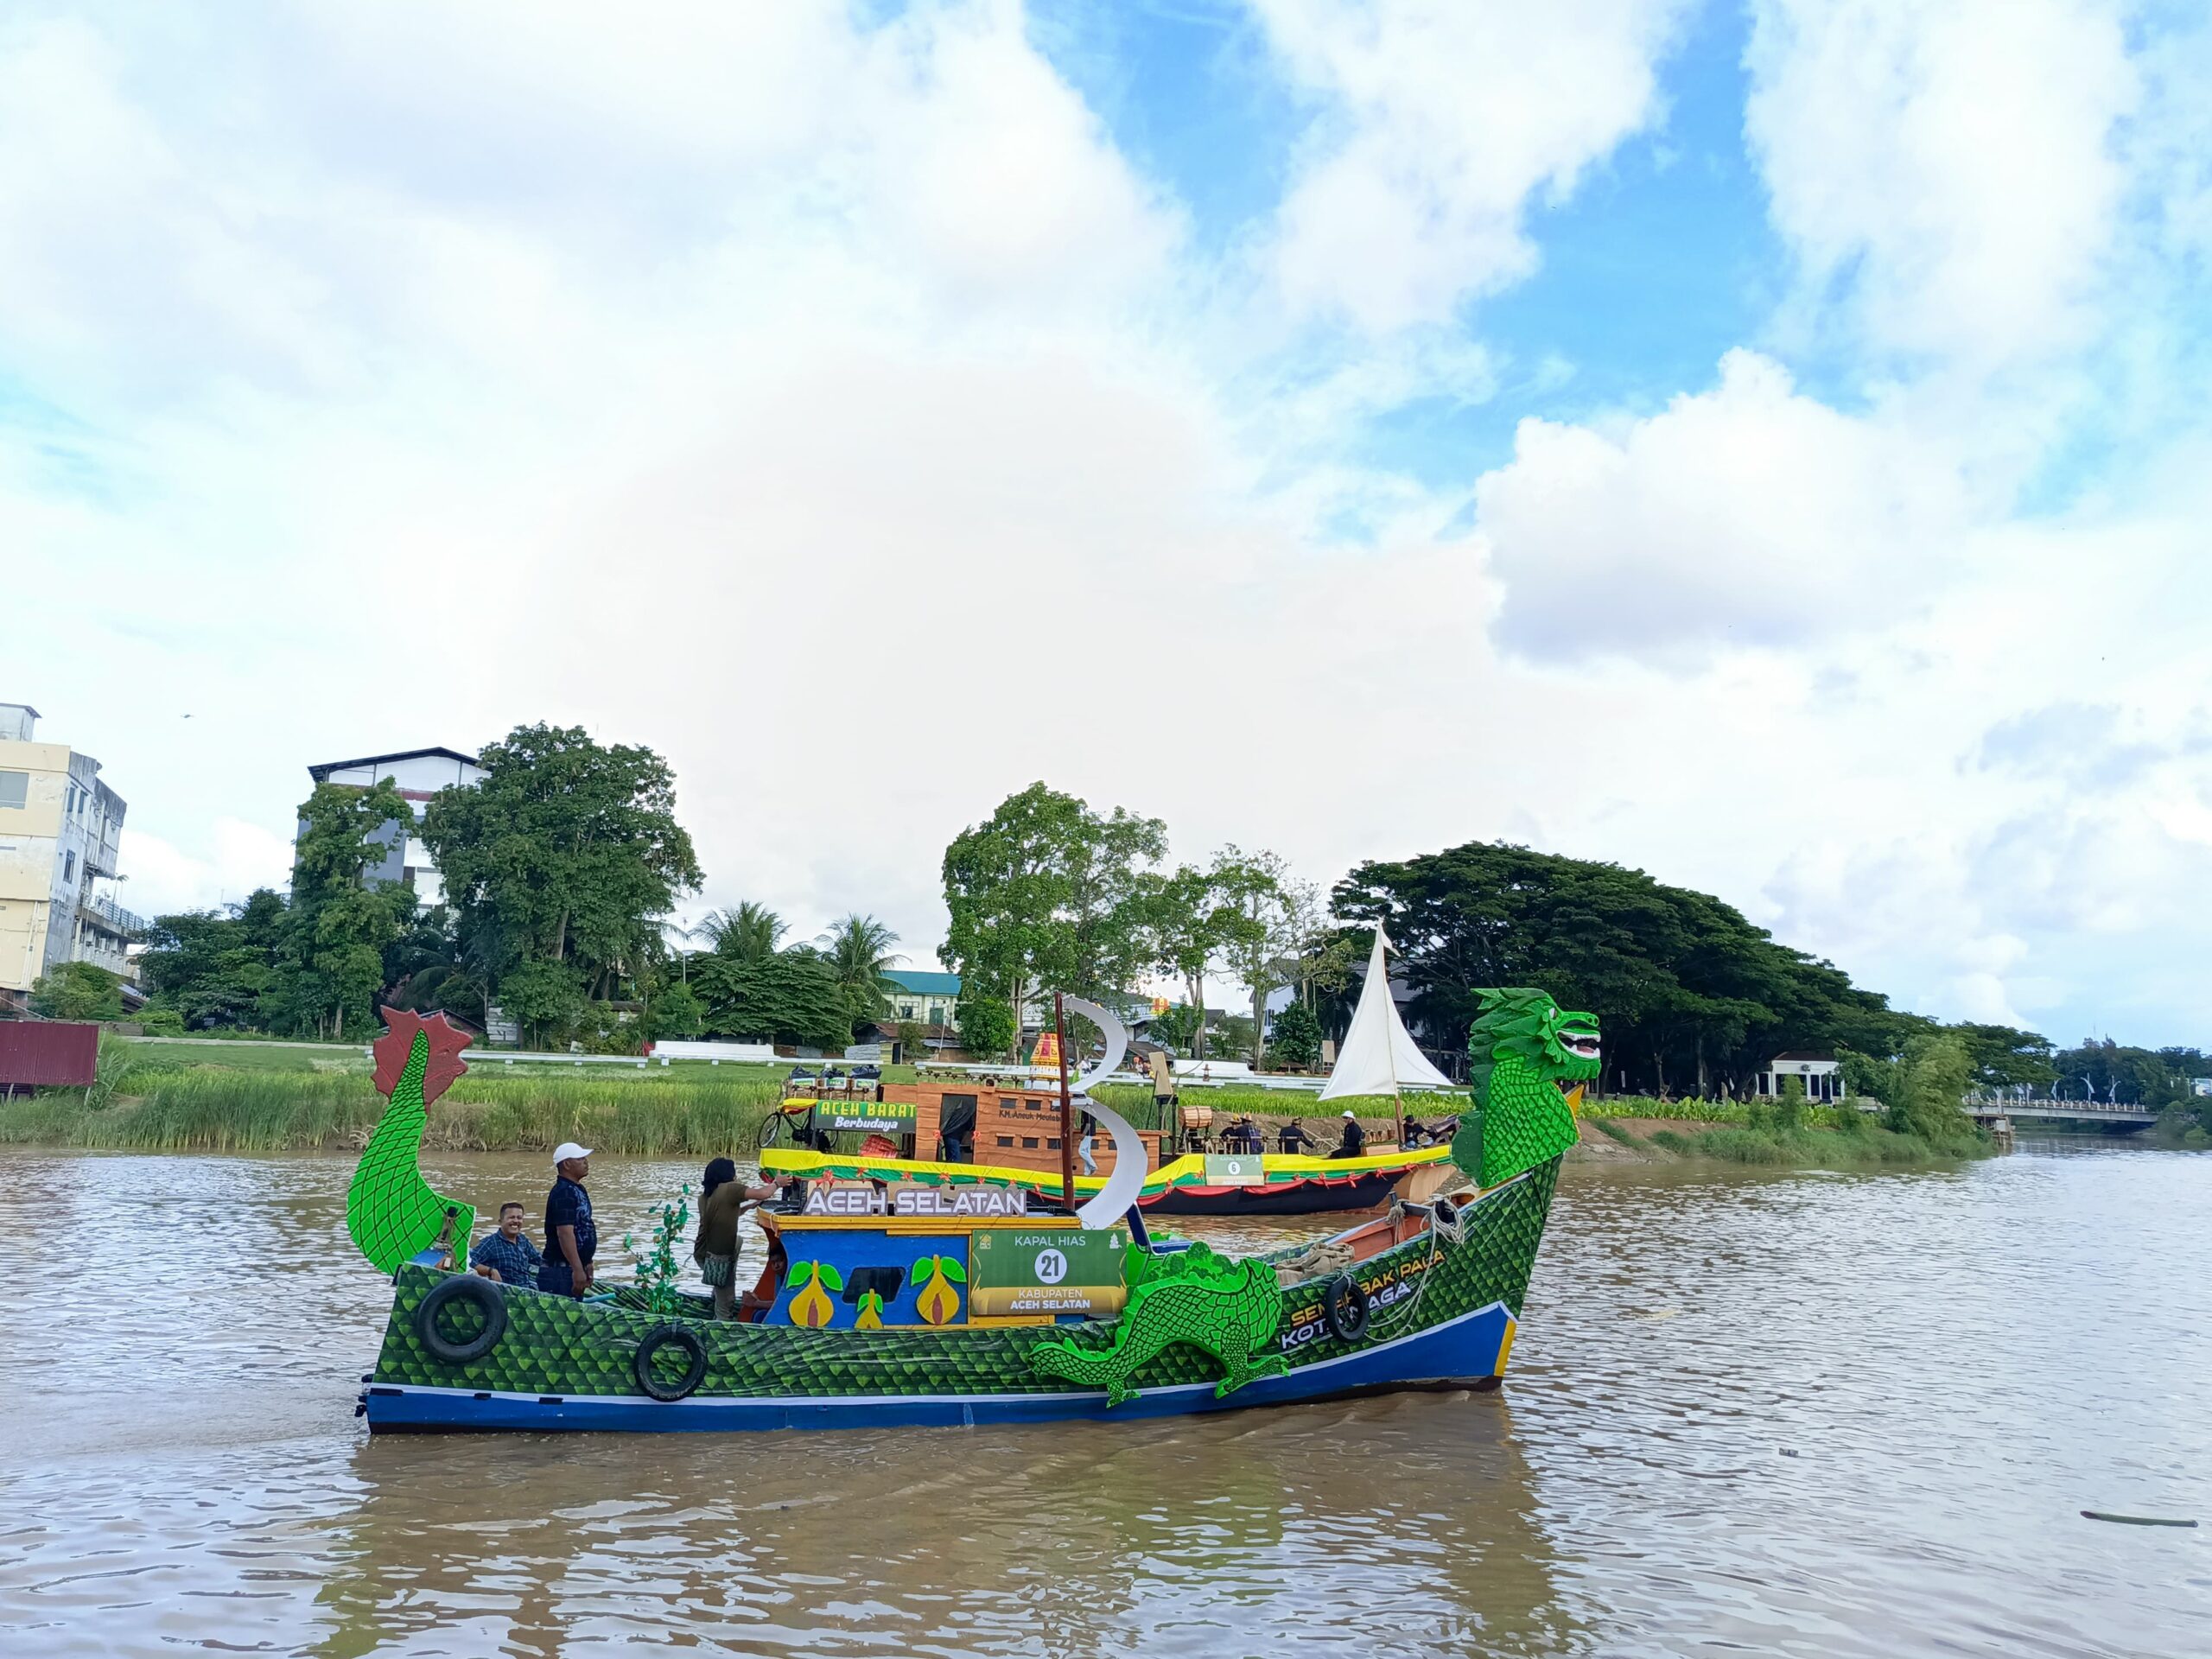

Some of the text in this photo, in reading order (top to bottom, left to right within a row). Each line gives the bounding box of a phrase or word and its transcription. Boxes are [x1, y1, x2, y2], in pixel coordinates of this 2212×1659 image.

[821, 1101, 916, 1117] ACEH BARAT
[835, 1116, 898, 1133] Berbudaya
[1231, 1164, 1236, 1173] 6
[805, 1191, 1025, 1213] ACEH SELATAN
[1014, 1236, 1086, 1247] KAPAL HIAS
[1041, 1255, 1059, 1277] 21
[1400, 1249, 1446, 1279] PALA
[1018, 1288, 1083, 1299] KABUPATEN
[1010, 1300, 1090, 1310] ACEH SELATAN
[1281, 1317, 1342, 1350] KOT
